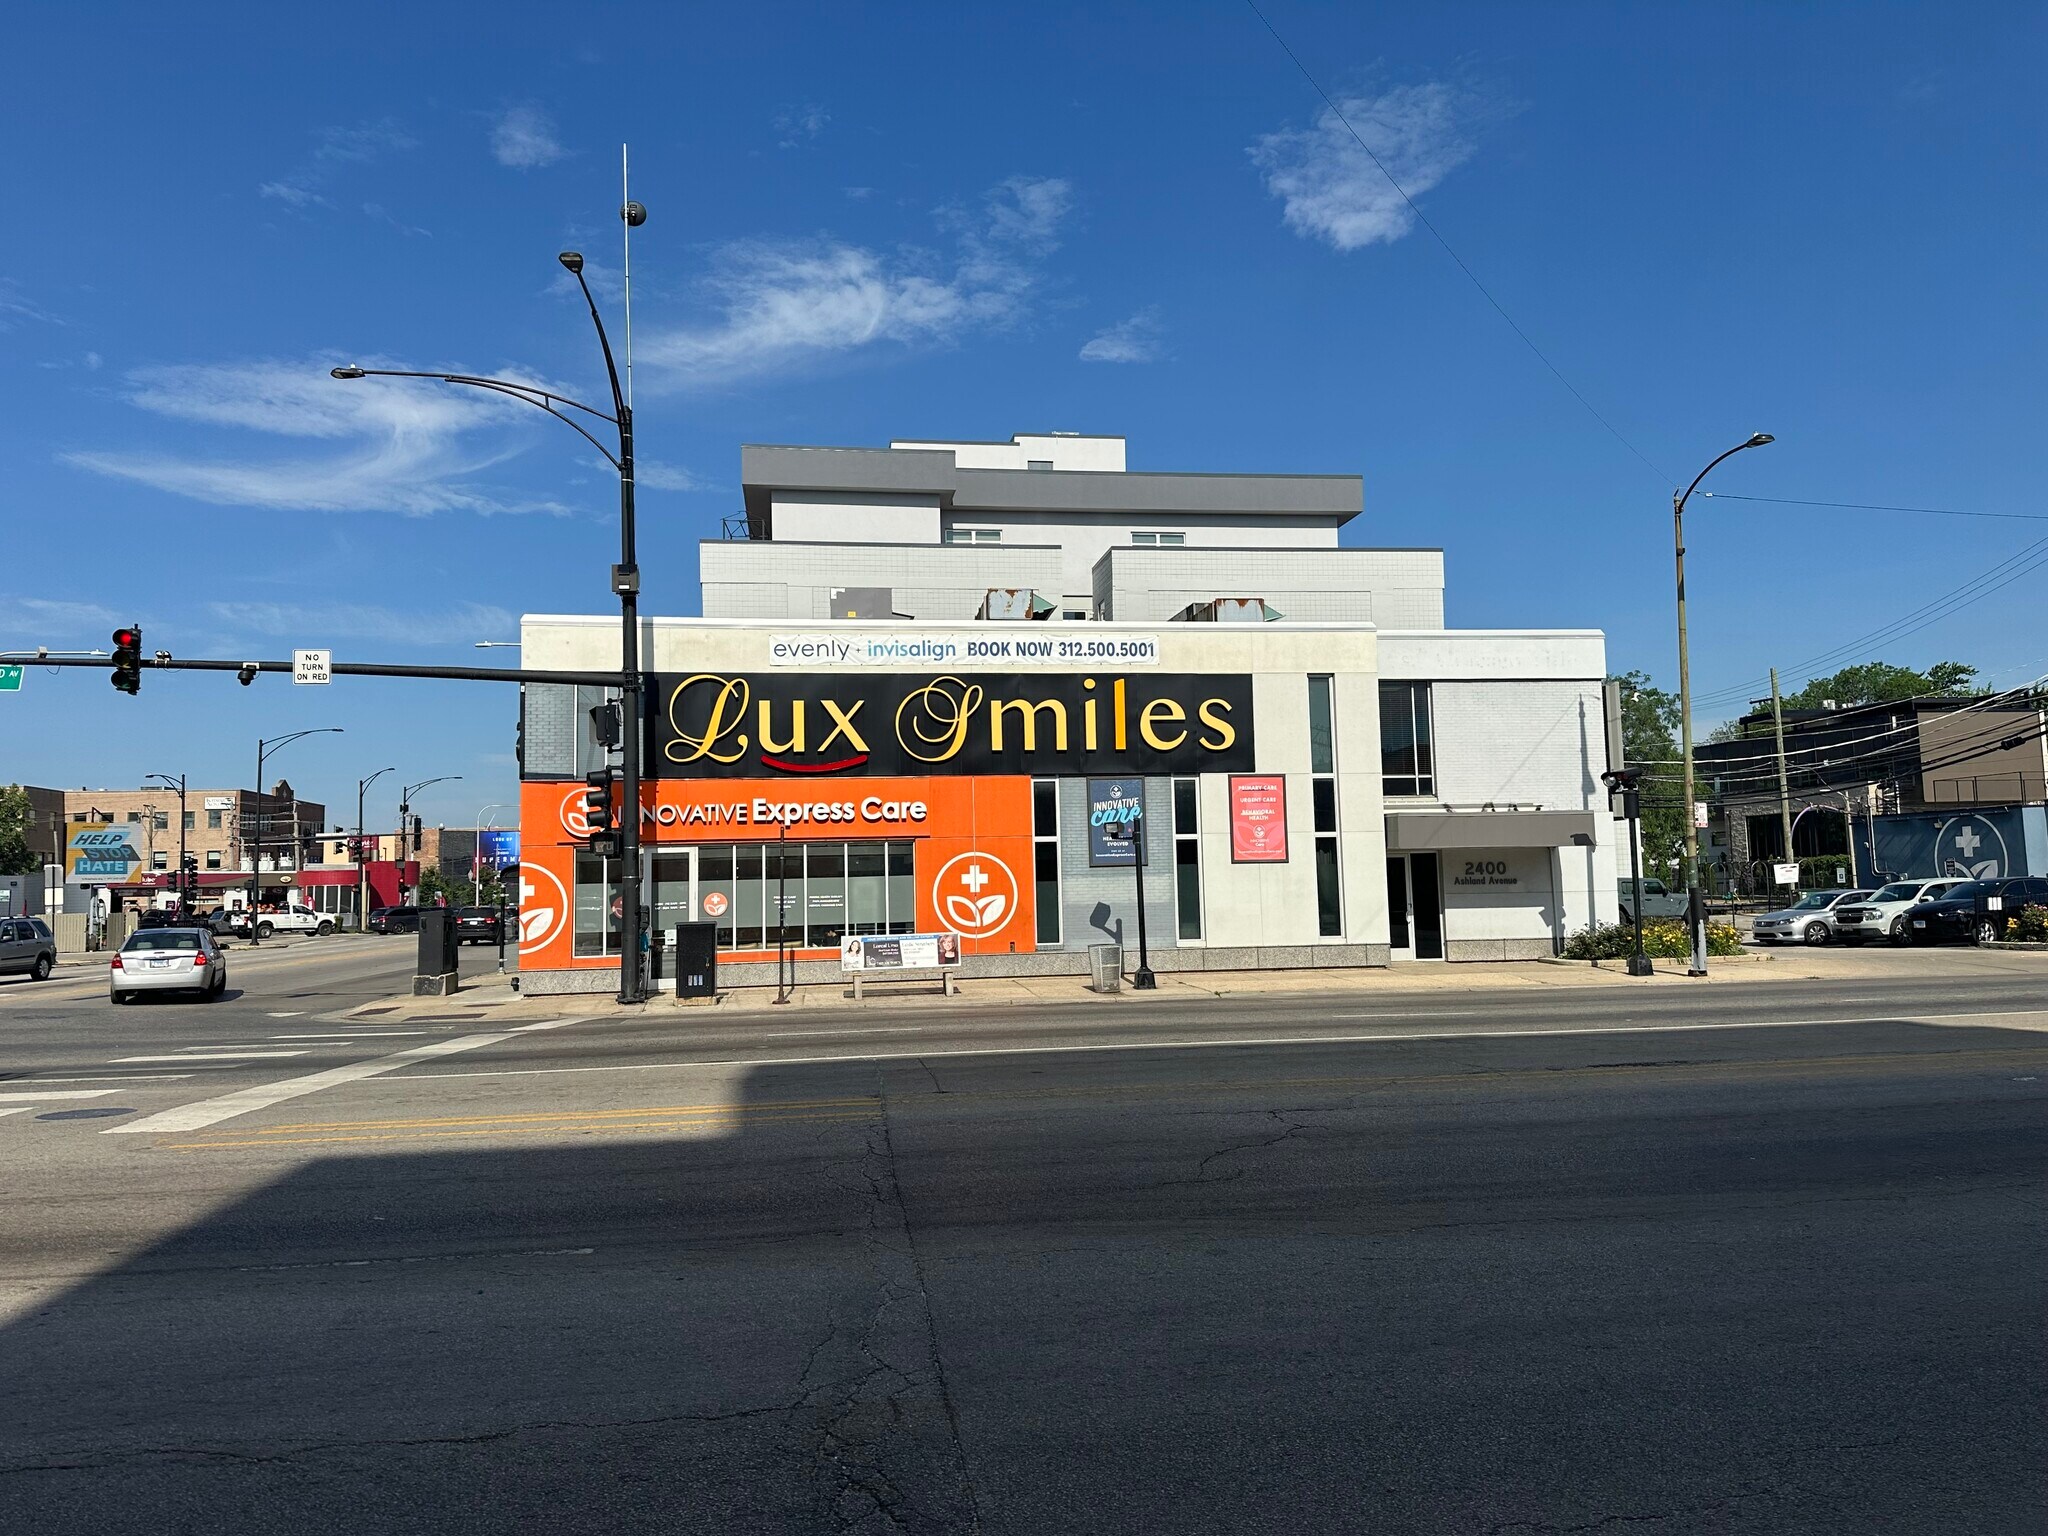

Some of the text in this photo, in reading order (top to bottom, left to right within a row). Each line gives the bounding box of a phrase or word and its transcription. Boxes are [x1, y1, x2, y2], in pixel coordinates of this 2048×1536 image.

[773, 640, 850, 660] evenly
[867, 640, 956, 661] invisalign
[967, 641, 1011, 656] BOOK
[1016, 642, 1053, 656] NOW
[1058, 642, 1155, 657] 312.500.5001
[301, 663, 324, 671] TURN
[664, 674, 1236, 763] Lux Smiles
[1093, 797, 1139, 812] INNOVATIVE
[617, 796, 927, 828] INOVATIVE Express Care
[1090, 806, 1143, 827] care
[75, 834, 123, 846] HELP
[87, 847, 132, 859] STOP
[79, 860, 124, 872] HATE
[1464, 861, 1507, 875] 2400
[1454, 876, 1518, 885] Ashland Avenue
